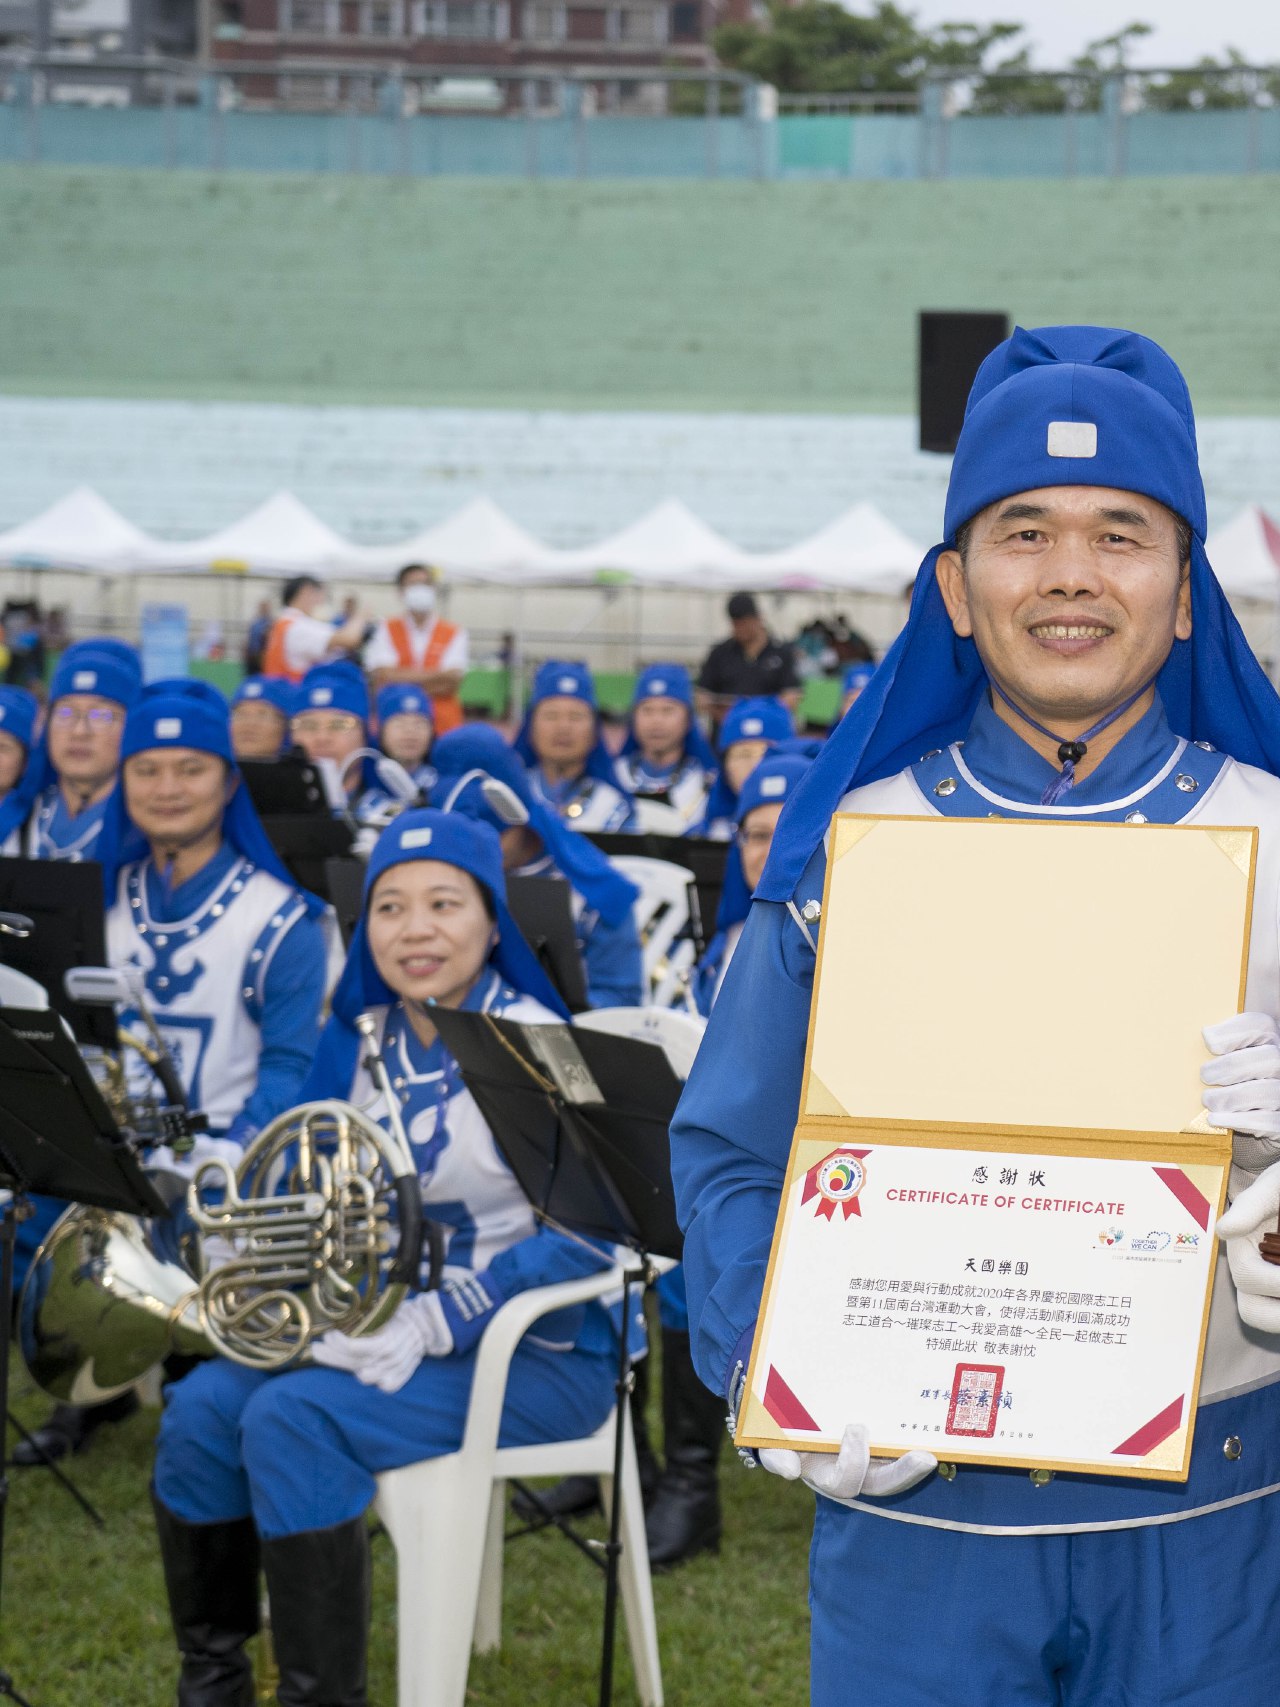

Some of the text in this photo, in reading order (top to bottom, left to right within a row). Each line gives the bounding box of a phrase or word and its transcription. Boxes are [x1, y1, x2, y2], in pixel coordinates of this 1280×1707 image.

[972, 1166, 1046, 1187] 感謝狀
[886, 1188, 1125, 1215] CERTIFICATE OF CERTIFICATE
[964, 1258, 1029, 1275] 天國樂團
[849, 1278, 1132, 1308] 感謝您用愛與行動成就2020年各界慶祝國際志工日
[926, 1337, 1037, 1357] 特頒此狀 敬表謝忱
